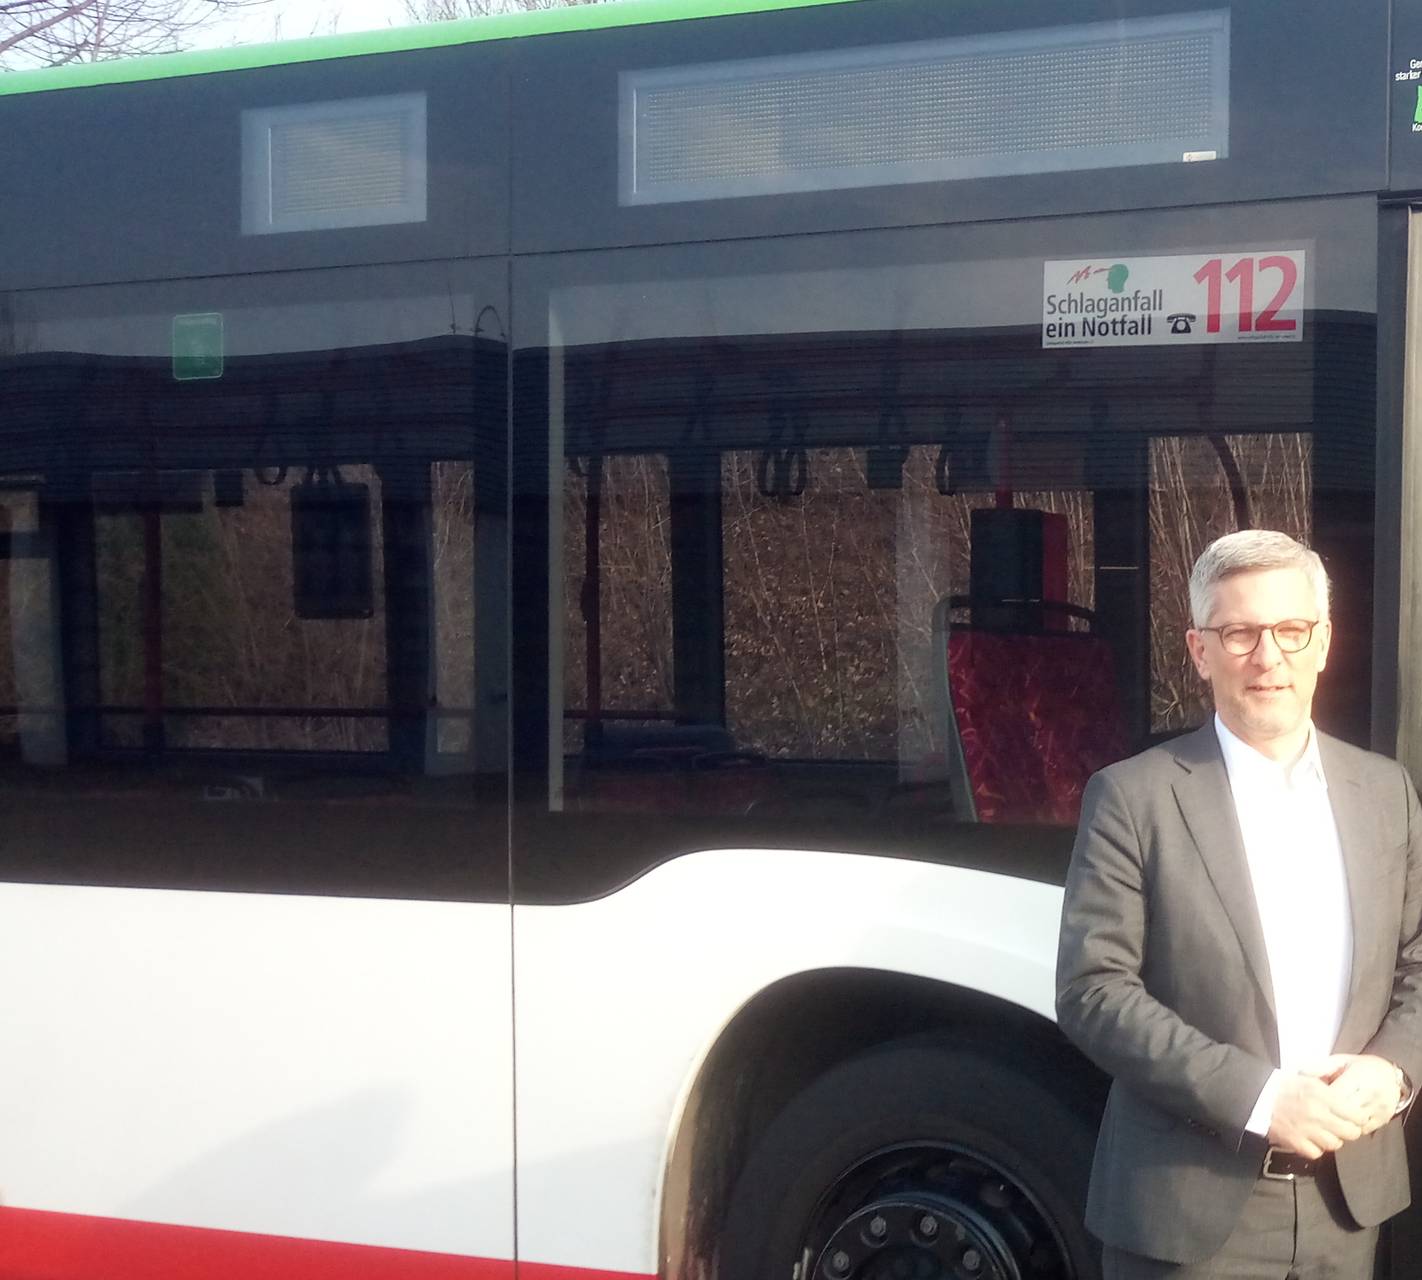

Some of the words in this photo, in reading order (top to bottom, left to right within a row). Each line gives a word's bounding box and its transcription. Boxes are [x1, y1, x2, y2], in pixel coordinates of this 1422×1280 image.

[1395, 70, 1421, 81] starker
[1047, 289, 1163, 319] Schlaganfall
[1193, 255, 1297, 334] 112
[1046, 321, 1076, 338] ein
[1082, 315, 1152, 337] Notfall
